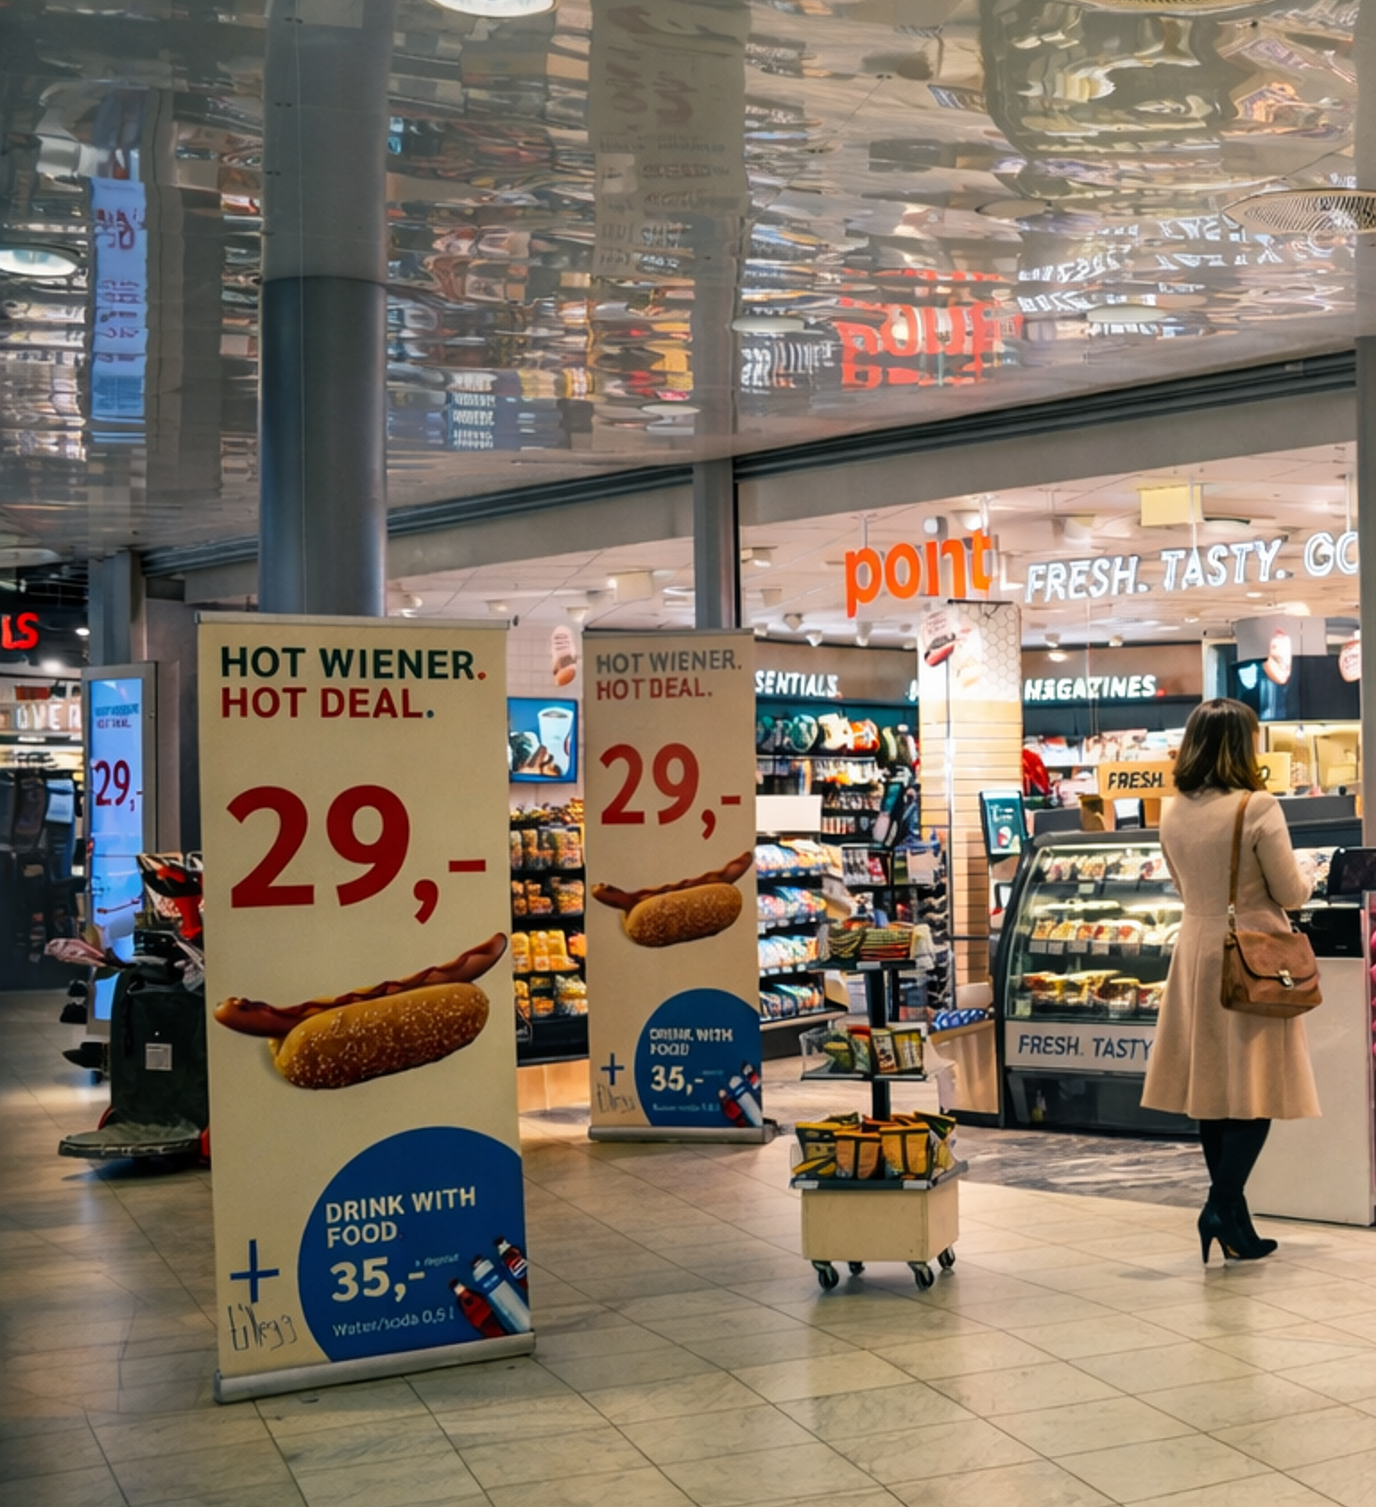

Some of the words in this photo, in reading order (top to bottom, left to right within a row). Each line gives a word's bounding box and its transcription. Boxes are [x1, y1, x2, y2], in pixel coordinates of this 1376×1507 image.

[845, 516, 993, 618] point
[1024, 553, 1150, 604] FRESH.
[1160, 534, 1288, 592] TASTY.
[220, 646, 306, 678] HOT
[319, 648, 486, 680] WIENER.
[596, 652, 644, 675] HOT
[649, 649, 743, 673] WIENER.
[221, 686, 307, 718] HOT
[320, 687, 435, 718] DEAL.
[596, 678, 645, 701] HOT
[649, 677, 713, 699] DEAL.
[599, 742, 742, 841] 29,-
[226, 785, 486, 925] 29,-
[325, 1194, 405, 1224] DRINK
[411, 1186, 476, 1213] WITH
[327, 1220, 398, 1249] FOOD
[329, 1256, 426, 1303] 35,-
